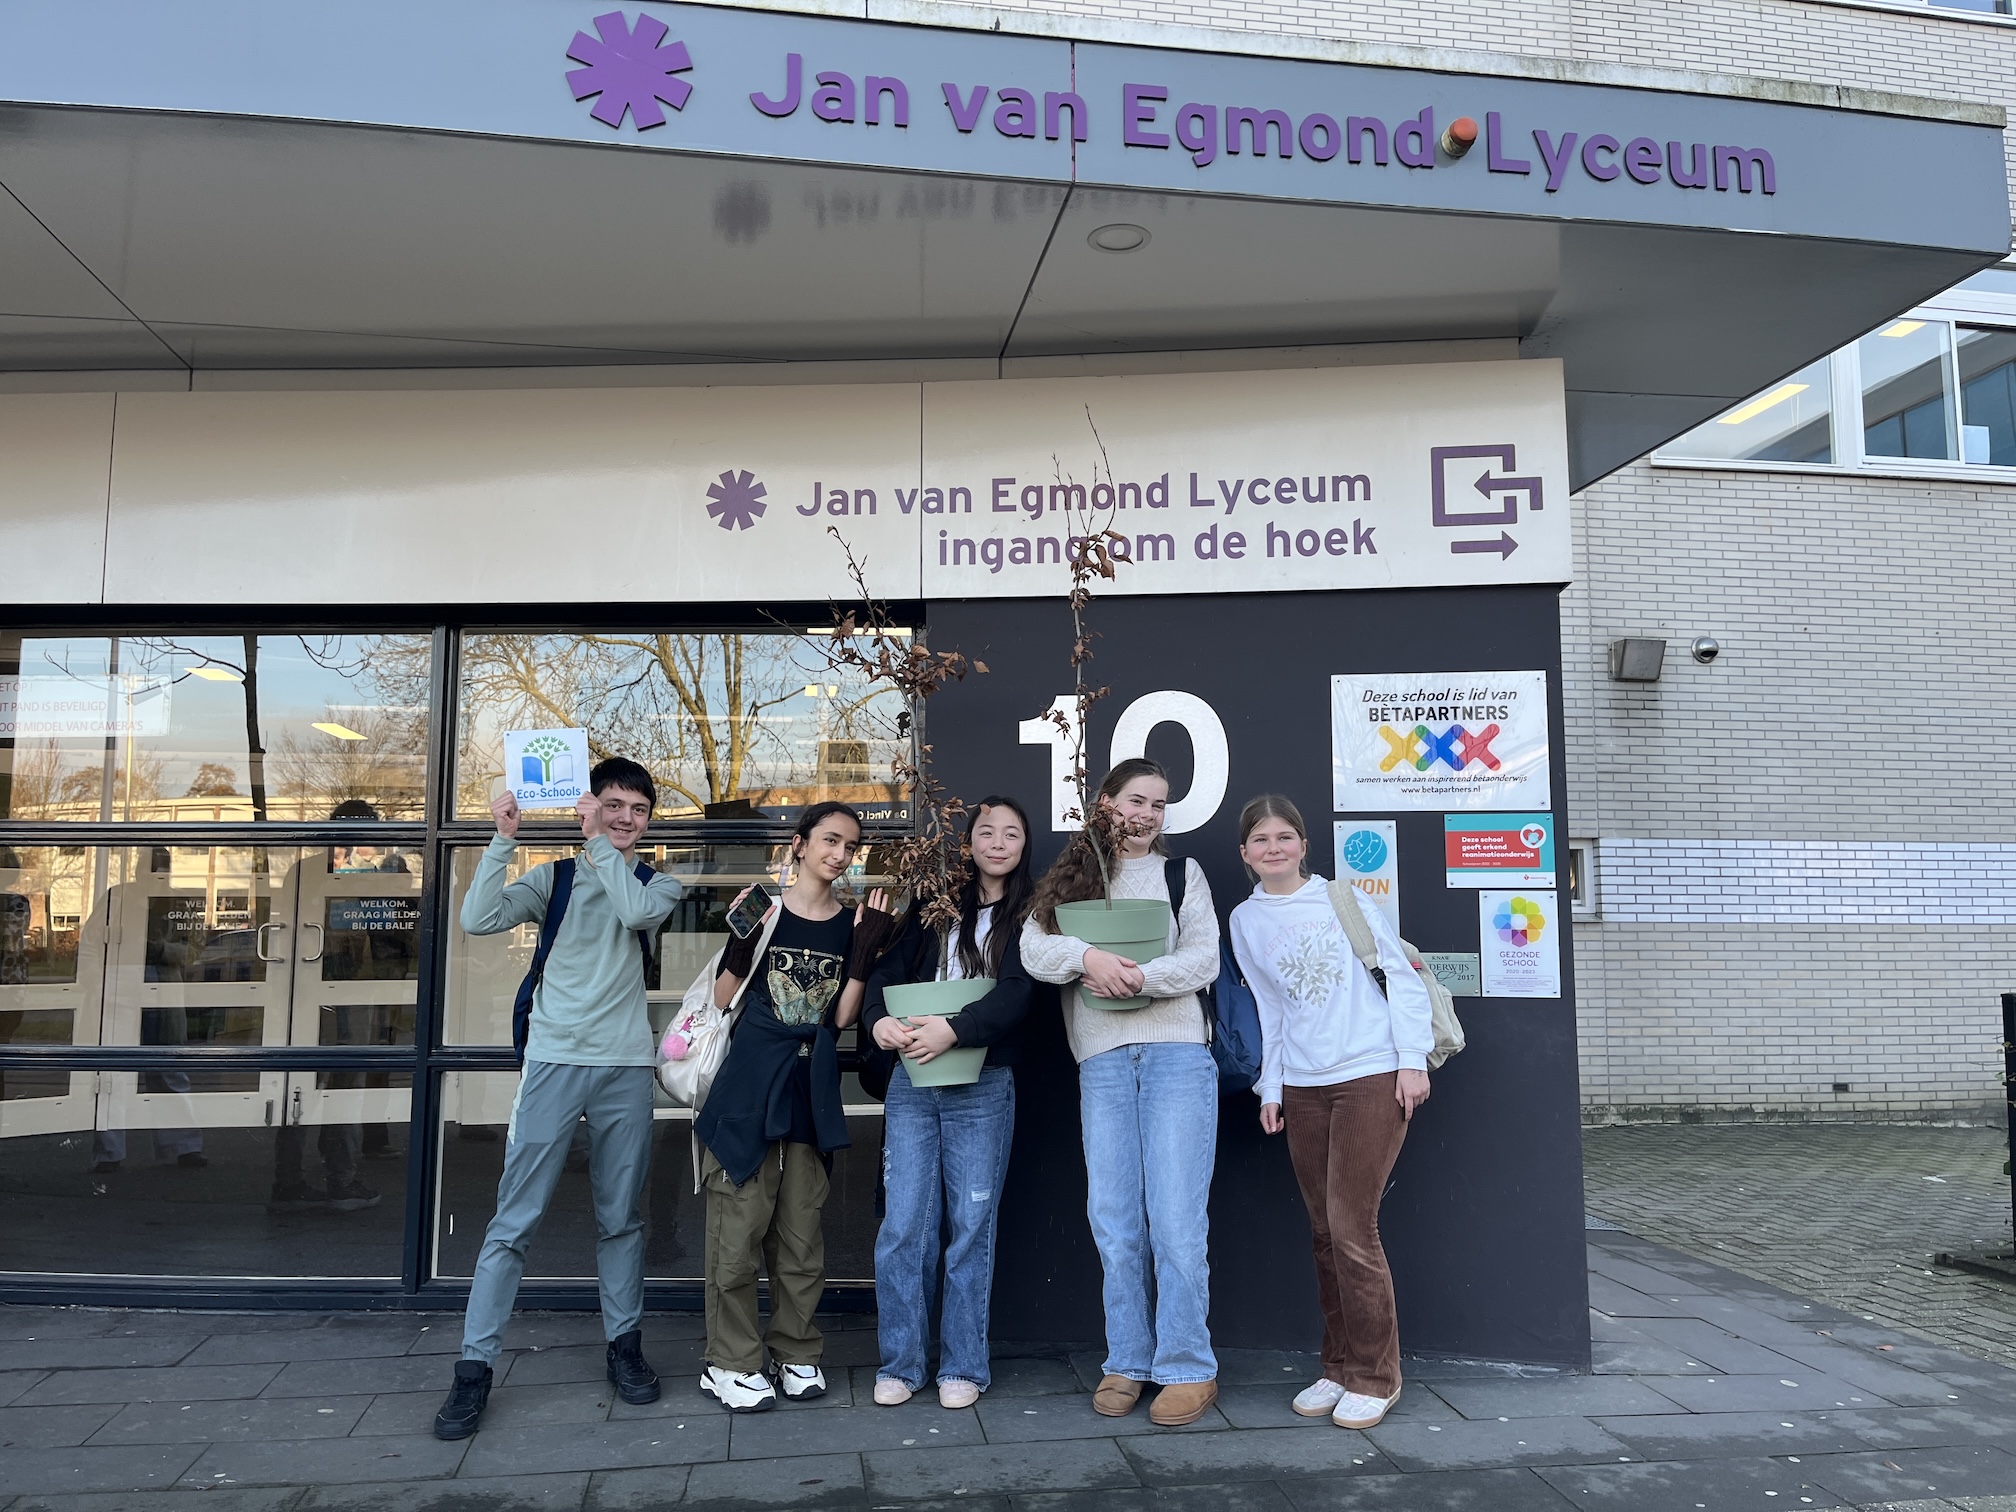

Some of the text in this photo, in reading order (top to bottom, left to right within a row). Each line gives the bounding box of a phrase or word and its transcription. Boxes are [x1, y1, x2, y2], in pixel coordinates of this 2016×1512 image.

[750, 53, 1778, 196] Jan van Egmond Lyceum
[795, 471, 1372, 521] Jan van Egmond Lyceum
[1107, 533, 1176, 562] om
[1193, 523, 1248, 560] de
[1265, 517, 1378, 558] hoek
[1362, 687, 1518, 703] Deze school is lid van
[11, 702, 40, 712] PAND
[42, 702, 51, 711] IS
[54, 701, 107, 712] BEVEILIGD
[24, 722, 64, 732] MIDDEL
[66, 722, 88, 731] VAN
[90, 721, 144, 731] CAMERA'S
[1018, 690, 1230, 835] 10
[1356, 776, 1382, 784] samen
[1383, 775, 1412, 784] werken
[1427, 775, 1472, 785] inspirerend
[516, 786, 581, 799] Eco-Schools
[1401, 785, 1482, 795] www.betapartners.nl
[1461, 843, 1508, 851] geeft erkend
[1461, 851, 1535, 859] reanimatieonderwijs
[360, 900, 409, 908] WELKOM.
[343, 910, 381, 919] GRAAG
[176, 922, 193, 931] BIJ
[195, 922, 209, 931] DE
[352, 922, 415, 930] BIJ DE BALIE
[1499, 951, 1541, 959] GEZONDE
[1502, 959, 1539, 967] SCHOOL
